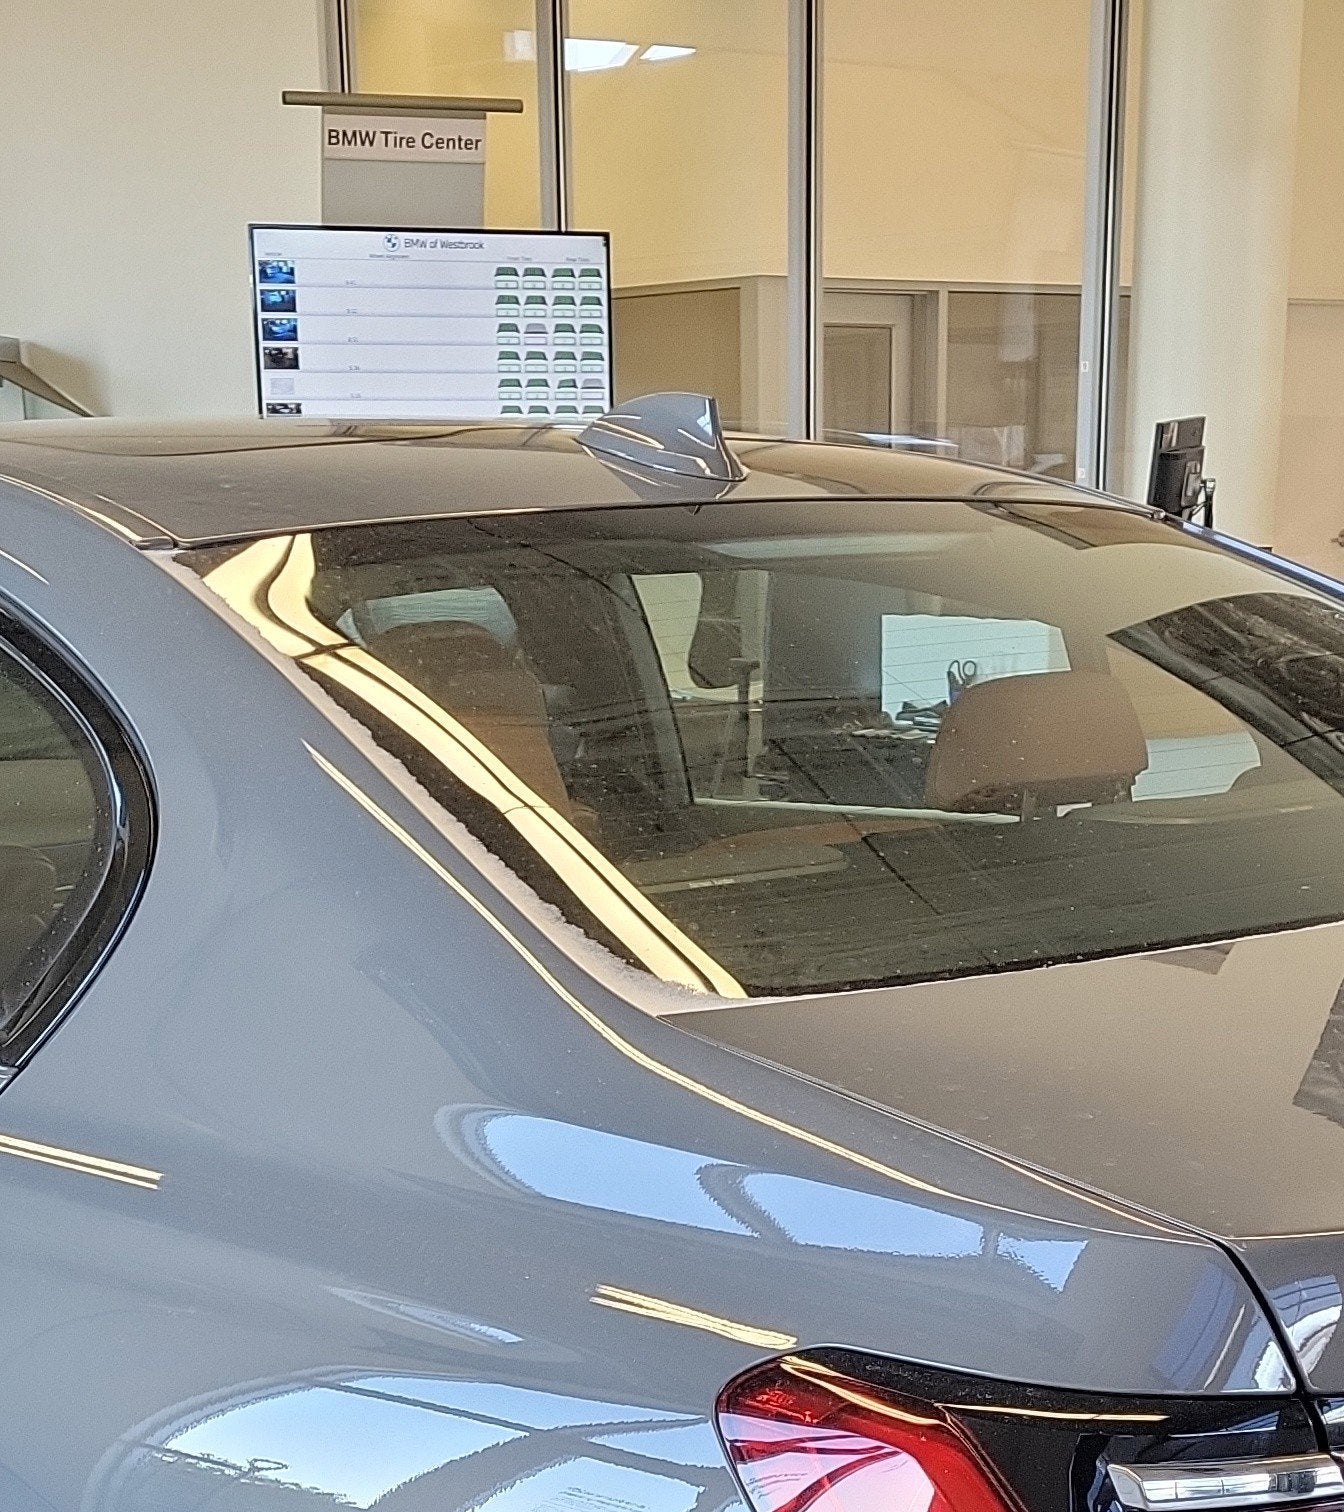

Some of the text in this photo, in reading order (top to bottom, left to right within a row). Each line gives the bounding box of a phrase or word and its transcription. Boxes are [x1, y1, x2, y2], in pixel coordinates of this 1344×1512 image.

[327, 129, 482, 150] BMW Tire Center
[404, 238, 427, 249] BMW
